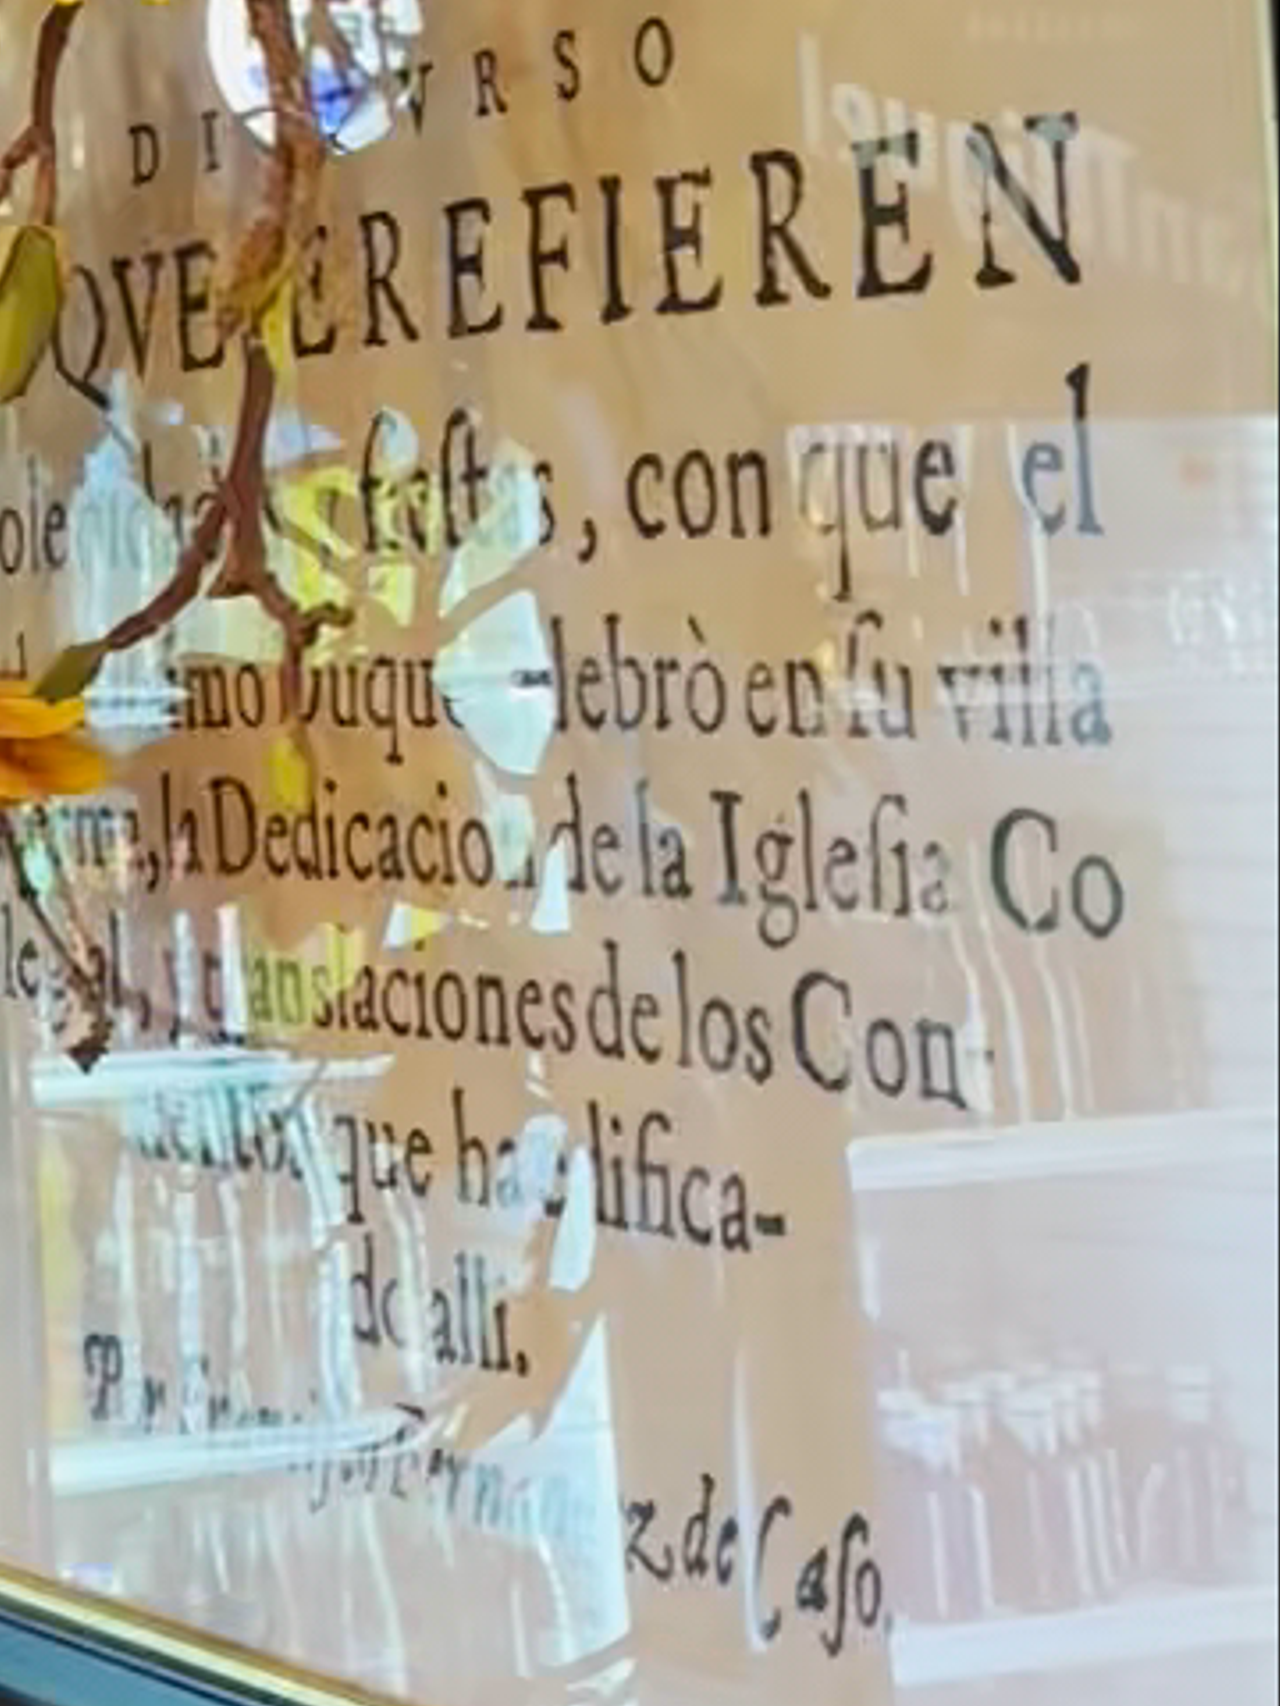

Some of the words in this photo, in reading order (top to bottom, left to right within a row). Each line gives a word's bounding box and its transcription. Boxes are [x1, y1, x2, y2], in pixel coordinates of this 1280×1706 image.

[626, 446, 771, 539] con
[798, 438, 958, 603] que
[1022, 362, 1105, 536] el
[744, 658, 825, 739] en
[937, 614, 1113, 746] villa
[989, 807, 1125, 939] Co
[203, 924, 578, 1054] tanslaciones
[586, 939, 662, 1065] de
[671, 948, 775, 1086] los
[543, 1100, 787, 1254] ifica-
